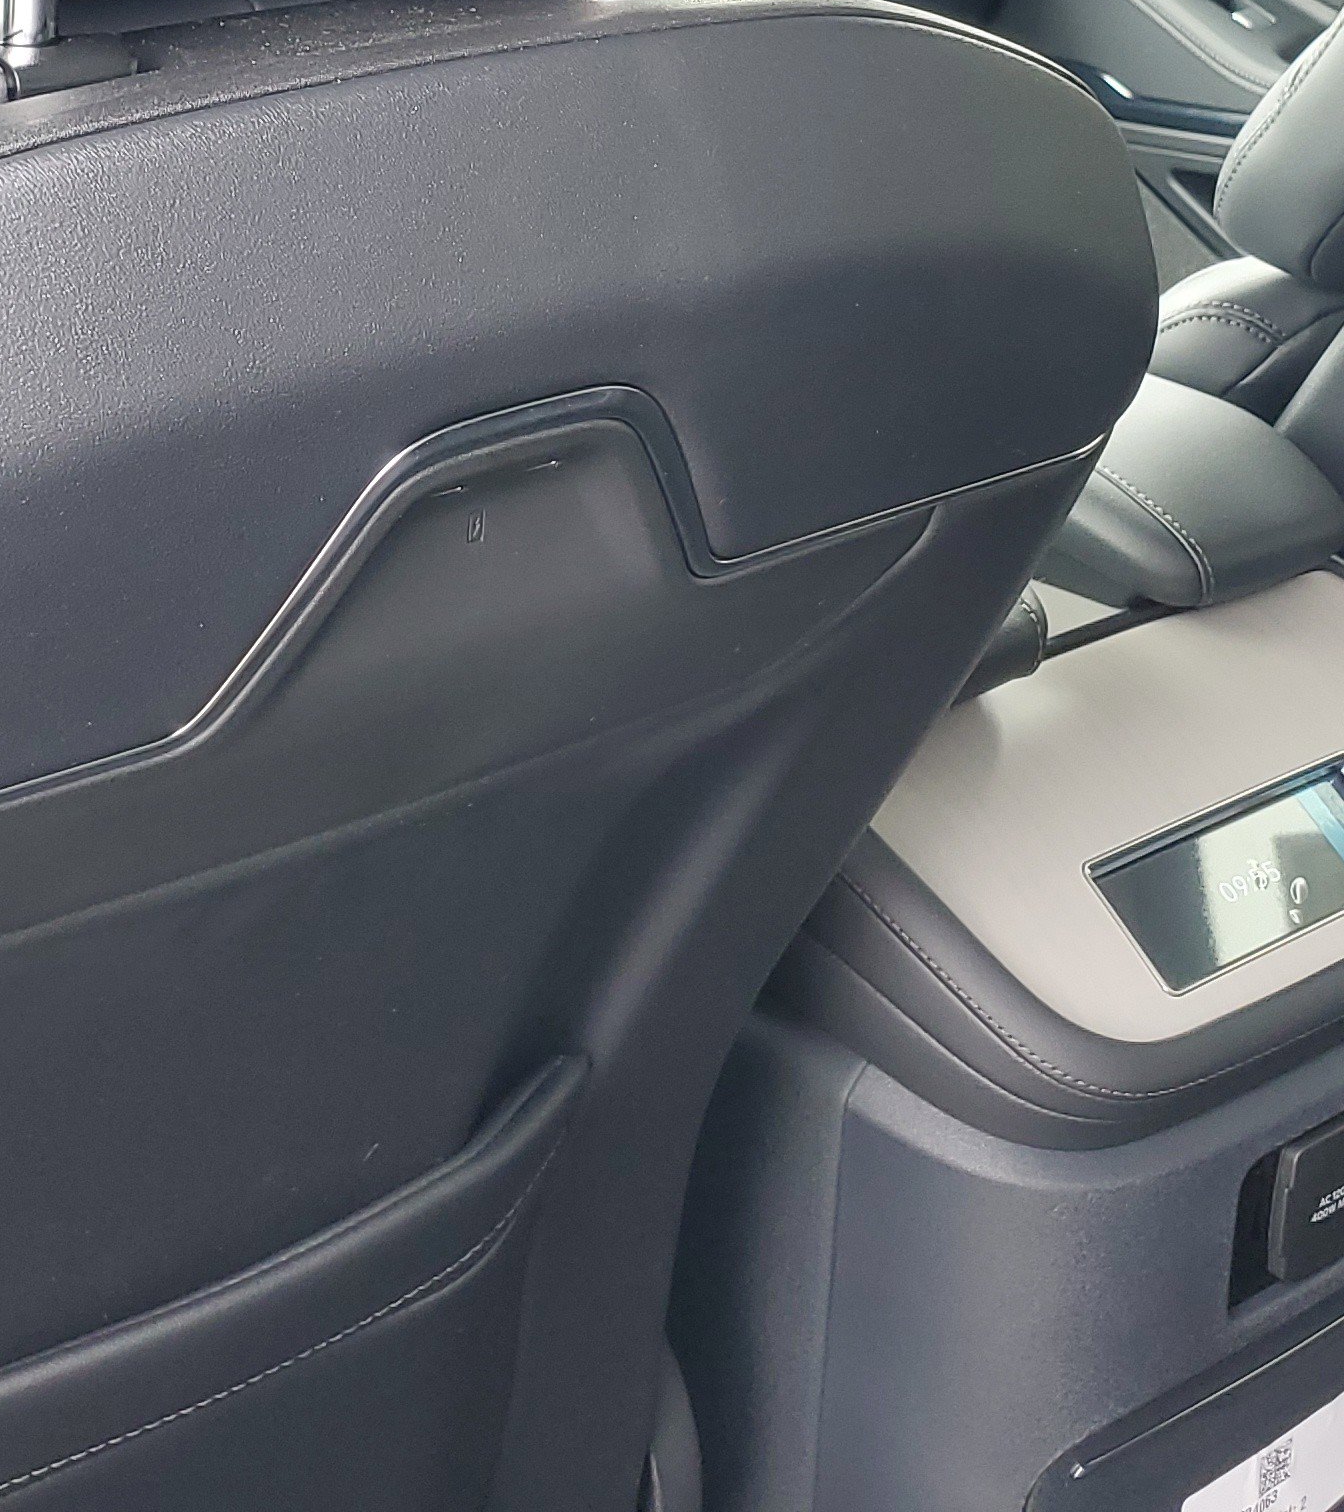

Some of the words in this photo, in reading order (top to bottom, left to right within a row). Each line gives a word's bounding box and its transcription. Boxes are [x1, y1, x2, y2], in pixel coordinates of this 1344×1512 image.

[1318, 1193, 1332, 1208] AC
[1309, 1202, 1337, 1223] 400W
[1241, 1489, 1278, 1512] 4063
